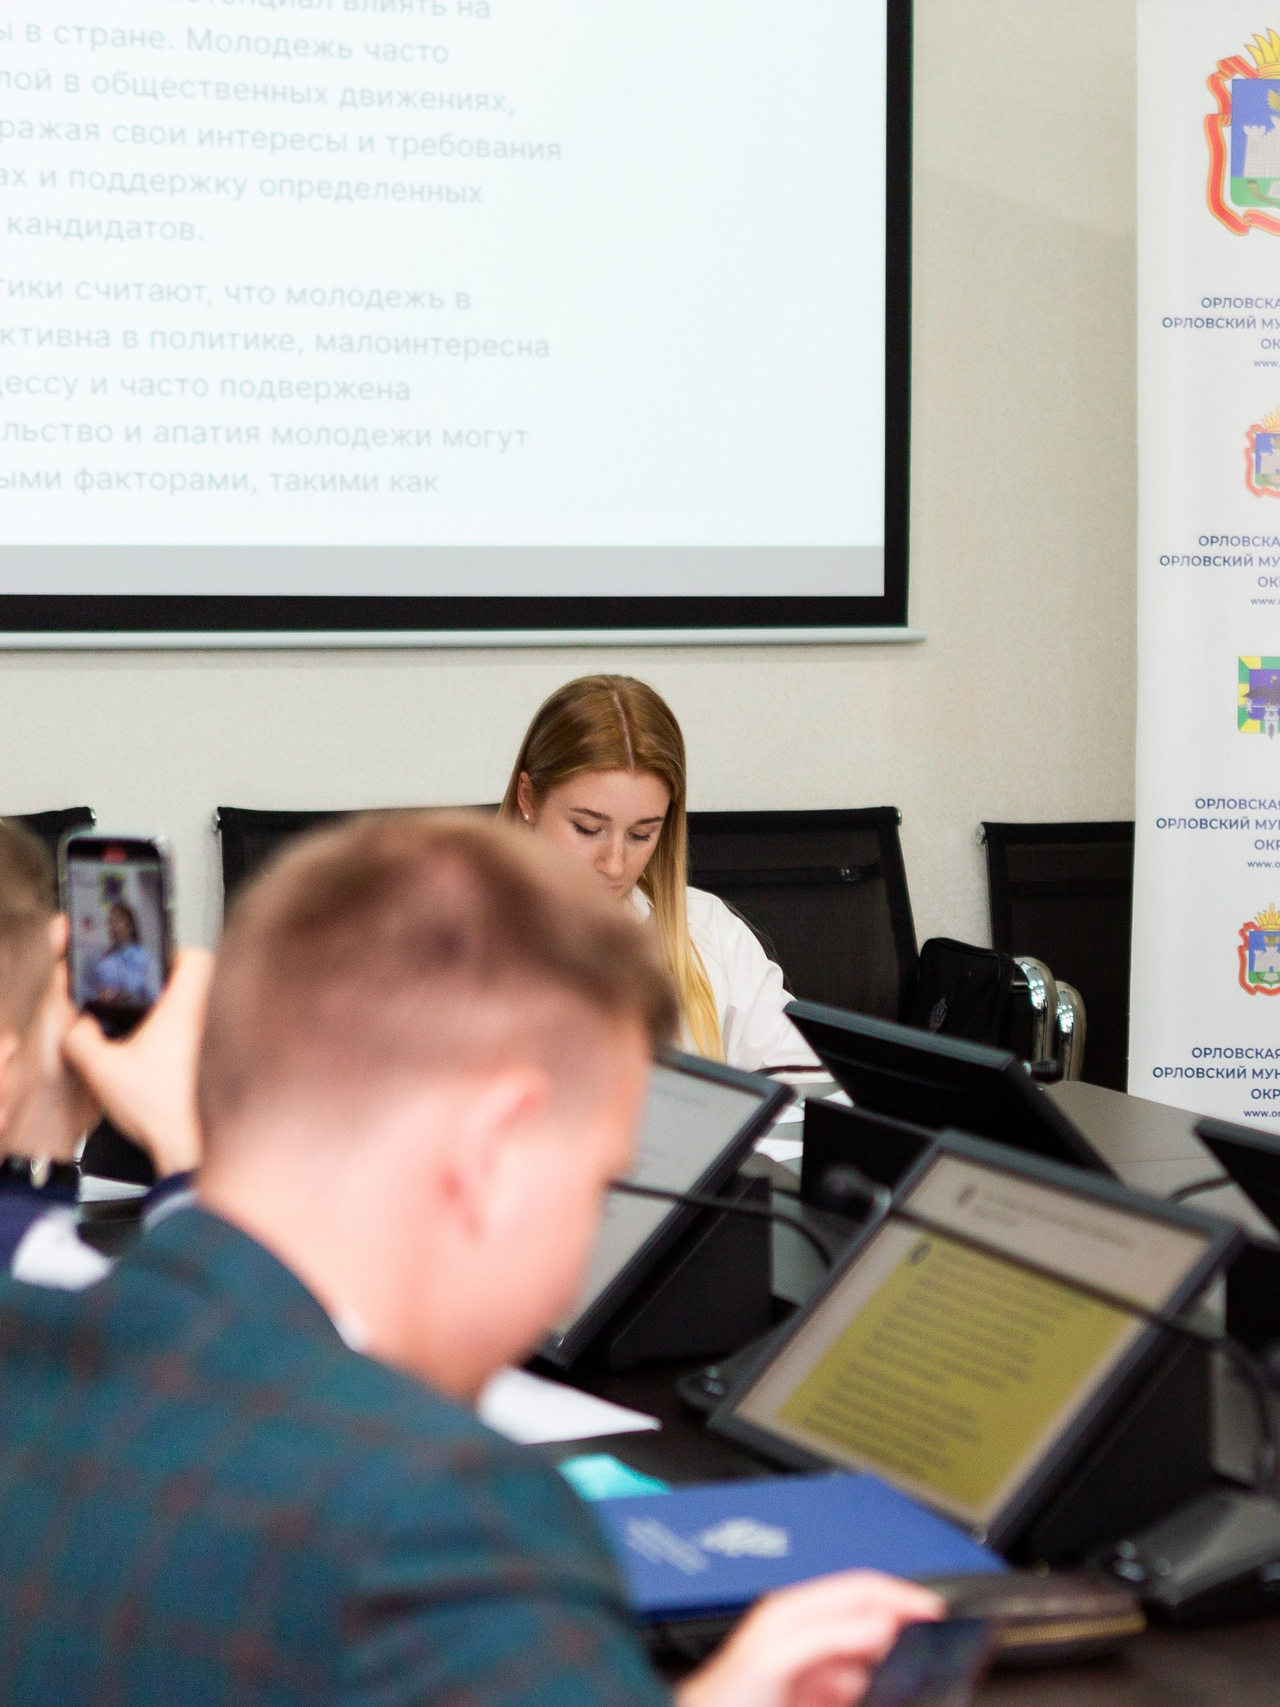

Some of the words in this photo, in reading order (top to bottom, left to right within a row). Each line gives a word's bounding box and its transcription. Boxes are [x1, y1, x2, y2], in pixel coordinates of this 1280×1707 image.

[458, 1, 491, 20] на
[26, 23, 42, 42] в
[53, 24, 174, 50] стране.
[186, 26, 353, 61] Молодежь
[364, 42, 449, 64] часто
[64, 73, 80, 94] в
[92, 72, 328, 106] общественных
[338, 87, 515, 118] движениях,
[112, 124, 186, 146] свои
[198, 128, 348, 155] интересы
[358, 134, 376, 154] и
[385, 132, 562, 161] требования
[40, 170, 57, 188] и
[69, 170, 248, 201] поддержку
[258, 178, 483, 204] определенных
[6, 216, 204, 243] кандидатов.
[75, 280, 213, 308] считают,
[224, 285, 275, 305] что
[286, 286, 444, 312] молодежь
[455, 290, 471, 310] в
[1162, 316, 1256, 328] ОРЛОВСКИЙ
[122, 329, 139, 348] в
[150, 330, 304, 358] политике,
[314, 334, 550, 362] малоинтересна
[0, 374, 79, 402] ессу
[90, 377, 108, 396] и
[120, 377, 208, 397] часто
[220, 378, 410, 405] подвержена
[124, 424, 142, 444] и
[153, 425, 260, 445] апатия
[272, 426, 432, 451] молодежи
[442, 428, 529, 454] могут
[74, 466, 258, 498] факторами,
[270, 472, 378, 492] такими
[390, 472, 439, 492] как
[1159, 554, 1253, 567] ОРЛОВСКИЙ
[1156, 817, 1250, 829] ОРЛОВСКИЙ
[1152, 1065, 1247, 1079] ОРЛОВСКИЙ
